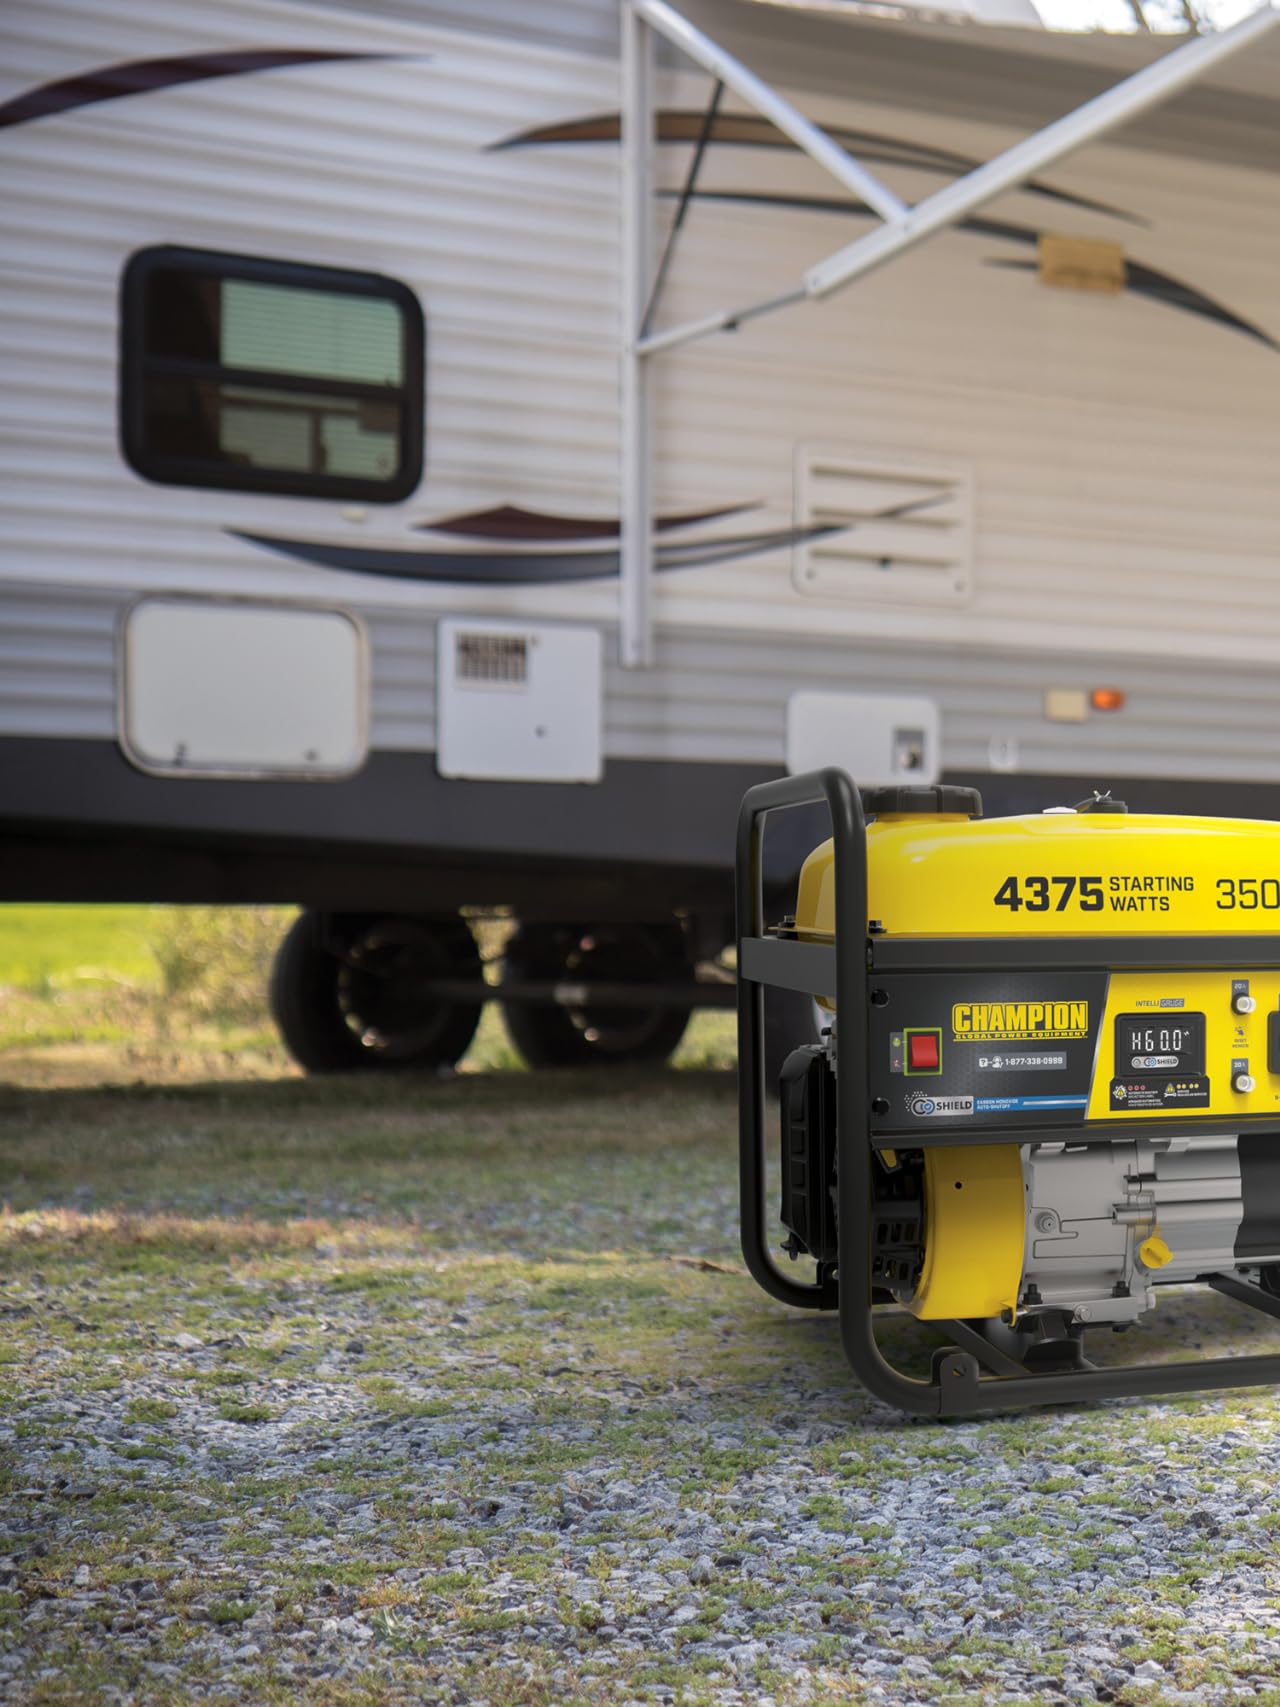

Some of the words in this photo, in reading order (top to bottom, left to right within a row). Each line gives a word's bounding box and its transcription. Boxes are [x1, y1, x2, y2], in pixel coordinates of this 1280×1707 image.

[1109, 876, 1194, 891] STARTING
[993, 876, 1104, 912] 4375
[1109, 896, 1170, 911] WATTS
[952, 1001, 1088, 1033] CHAMPION
[1157, 1057, 1178, 1065] SHIELD
[936, 1101, 972, 1111] SHIELD
